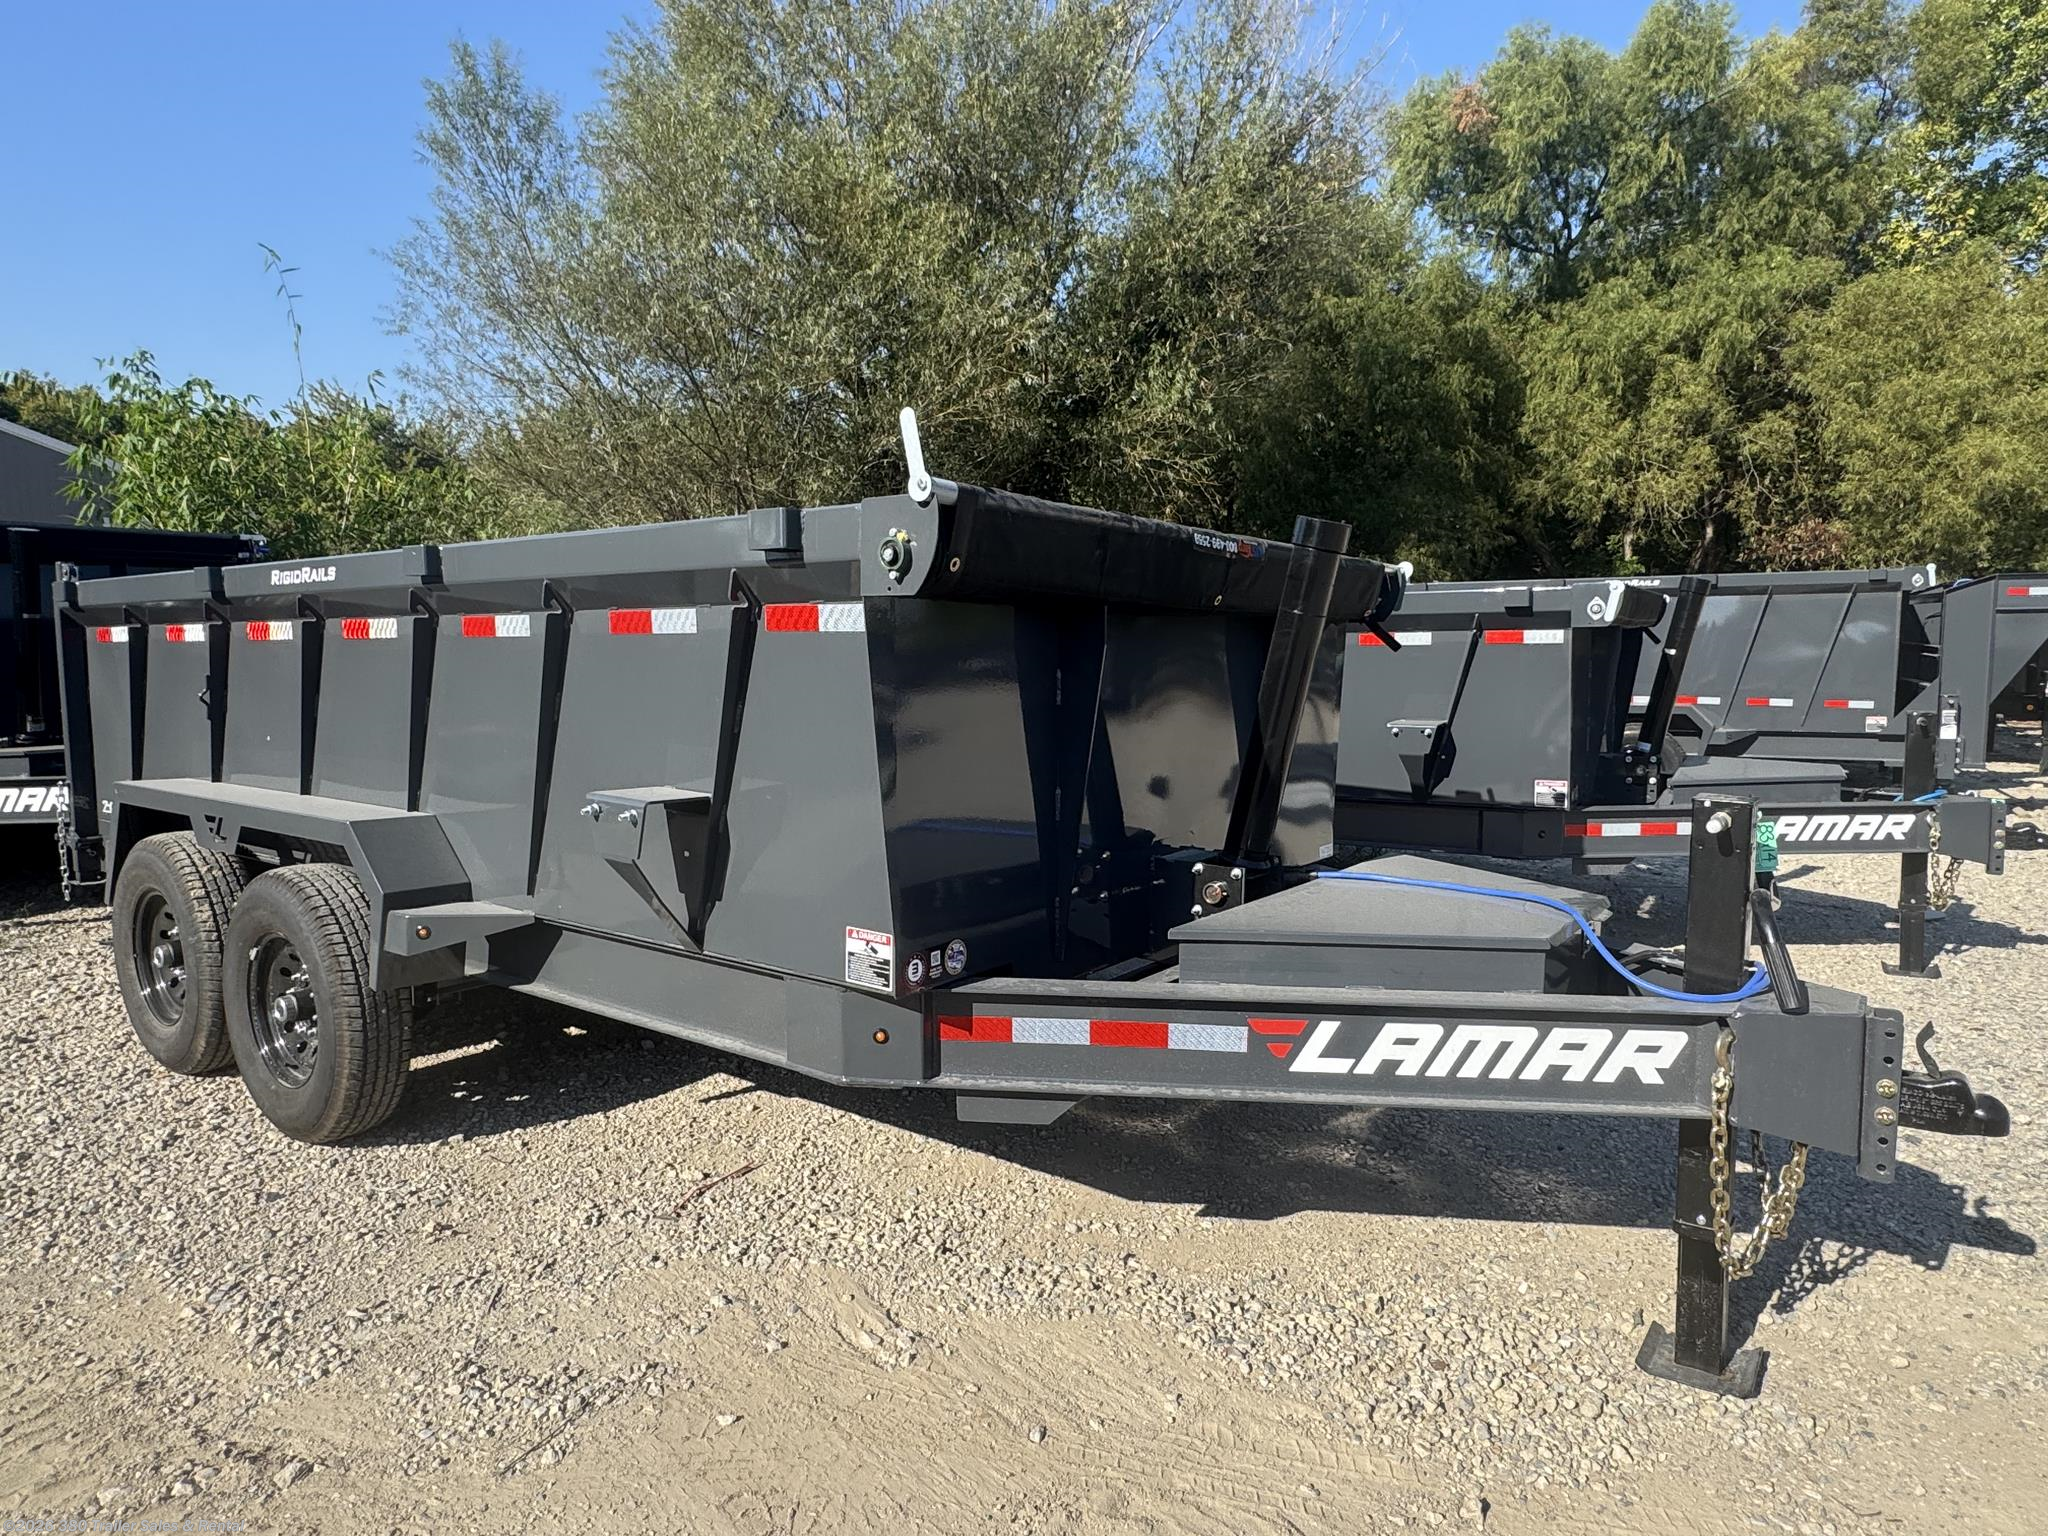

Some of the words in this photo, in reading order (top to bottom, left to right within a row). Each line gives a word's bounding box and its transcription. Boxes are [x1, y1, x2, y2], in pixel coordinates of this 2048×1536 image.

[1774, 814, 1917, 842] AMAR
[858, 931, 887, 944] DANGER
[1289, 1020, 1689, 1085] LAMAR
